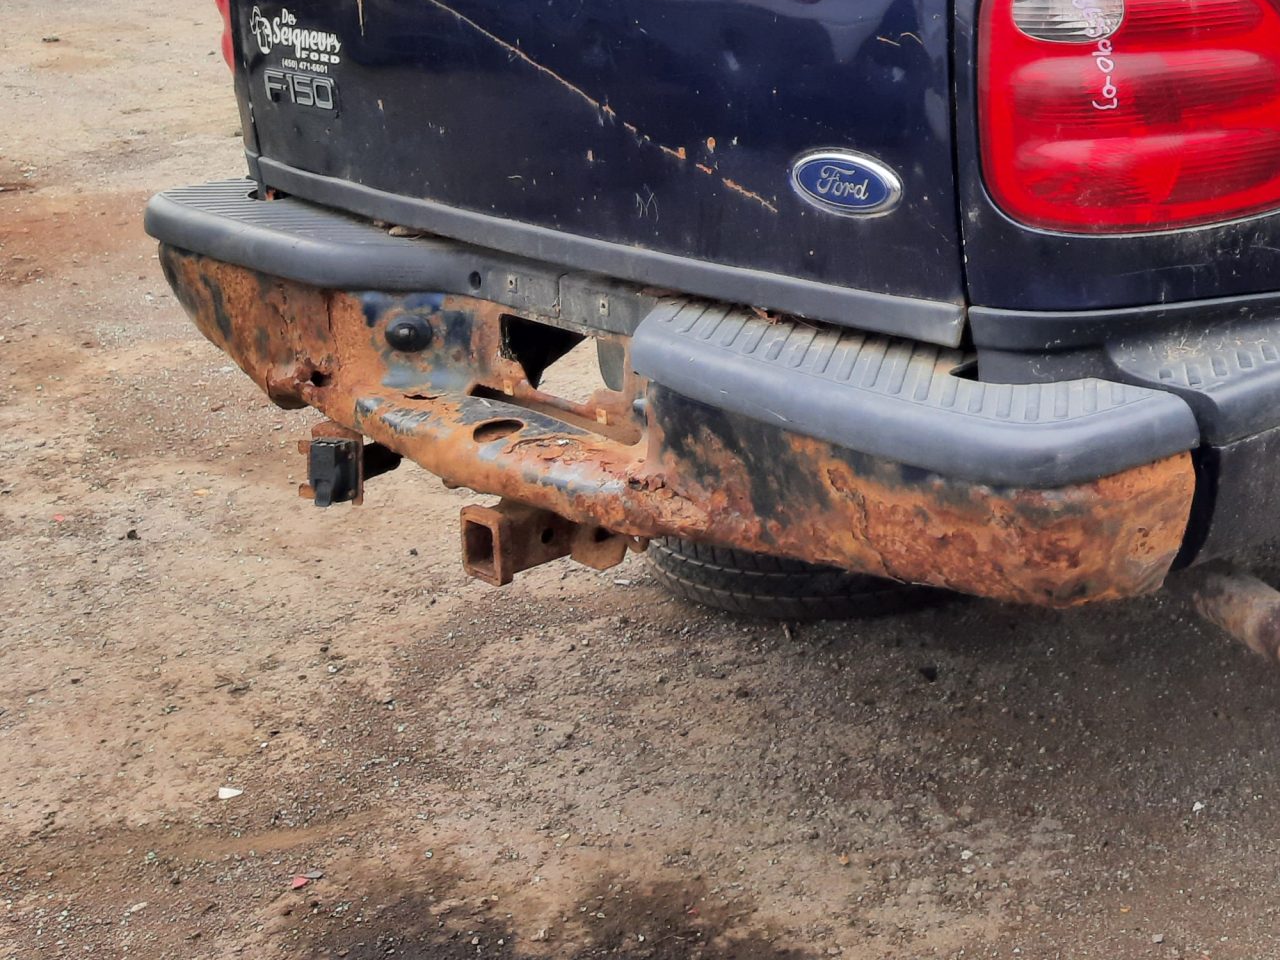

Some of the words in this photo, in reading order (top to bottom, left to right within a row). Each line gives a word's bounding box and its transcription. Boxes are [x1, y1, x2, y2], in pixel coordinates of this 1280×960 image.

[272, 16, 342, 58] Seigneurs
[301, 50, 341, 64] FORD
[816, 165, 869, 200] Ford
